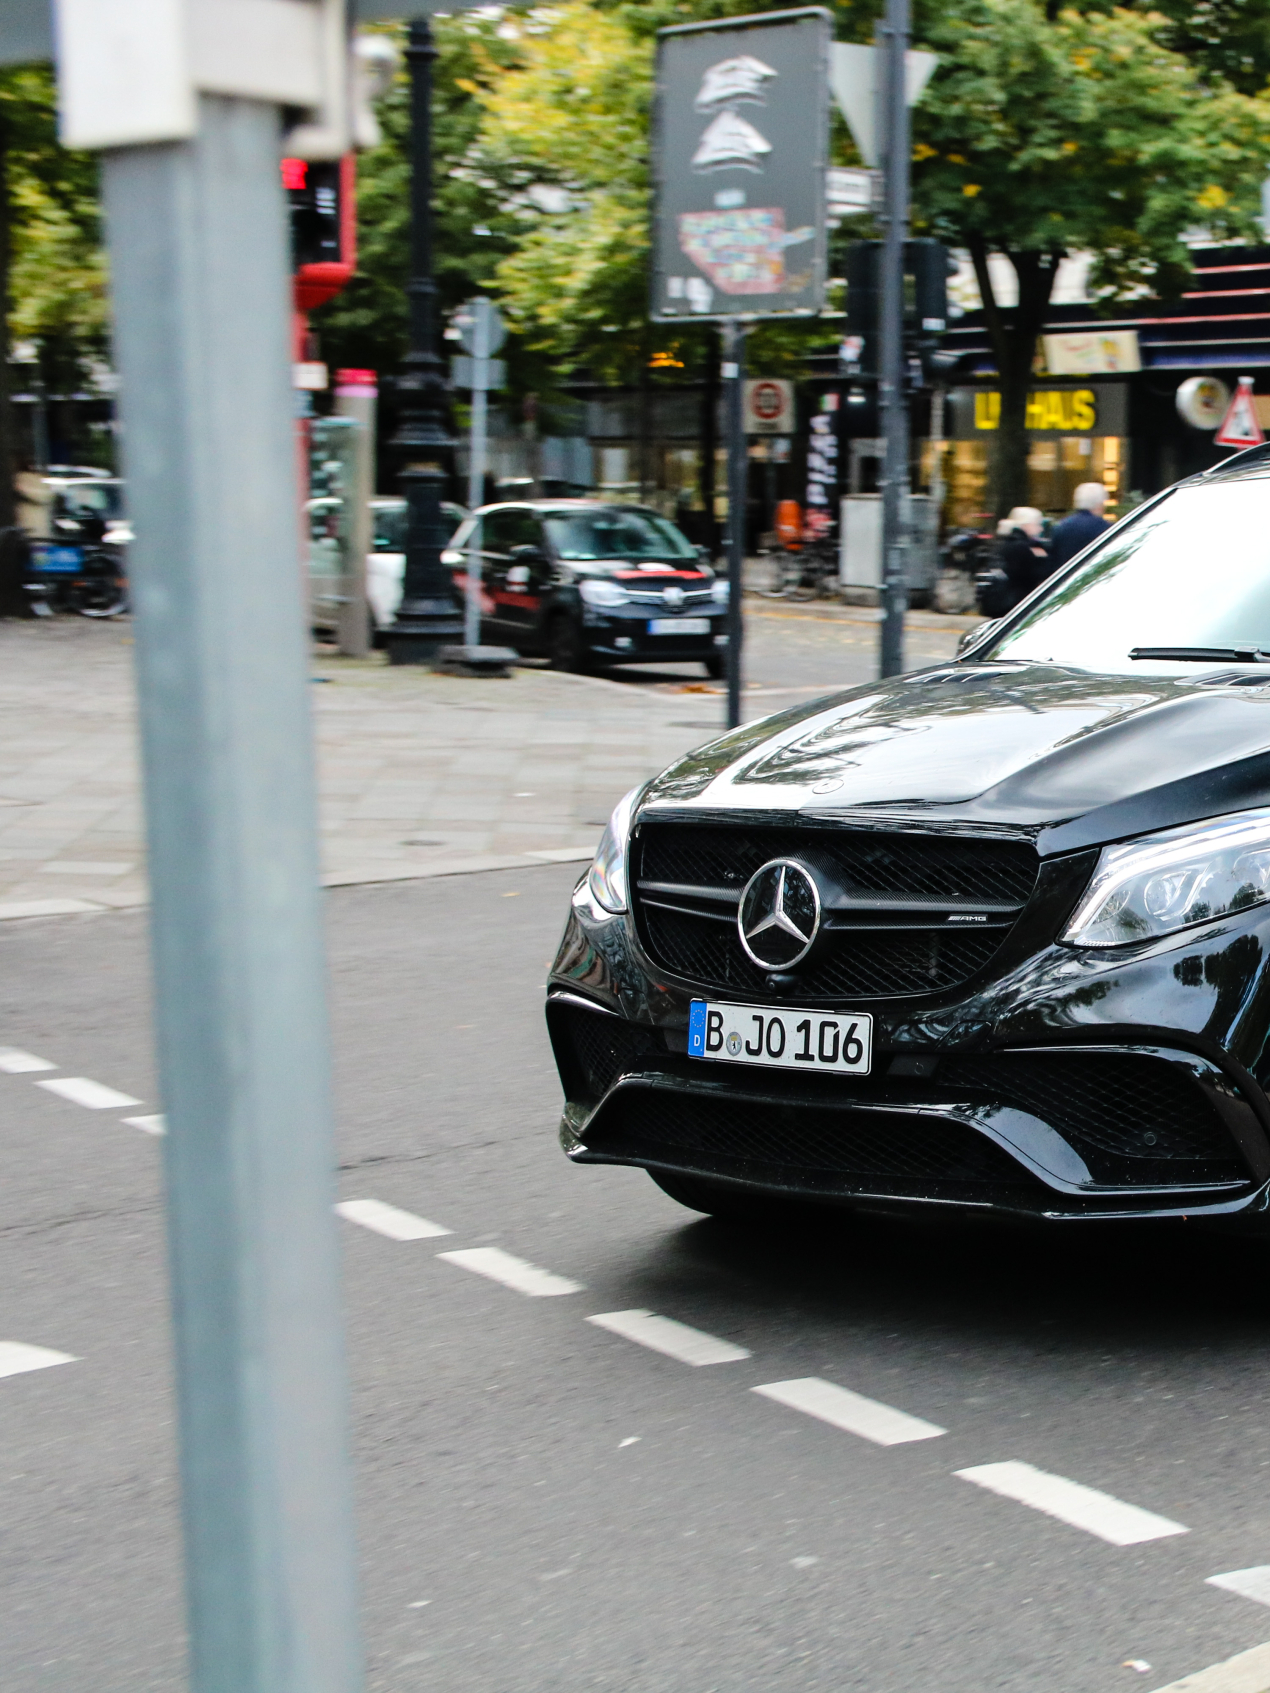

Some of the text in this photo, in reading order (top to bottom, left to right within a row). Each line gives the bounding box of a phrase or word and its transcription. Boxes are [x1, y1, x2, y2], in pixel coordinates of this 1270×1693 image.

[693, 1034, 701, 1047] D
[706, 1010, 864, 1065] B JO 106
